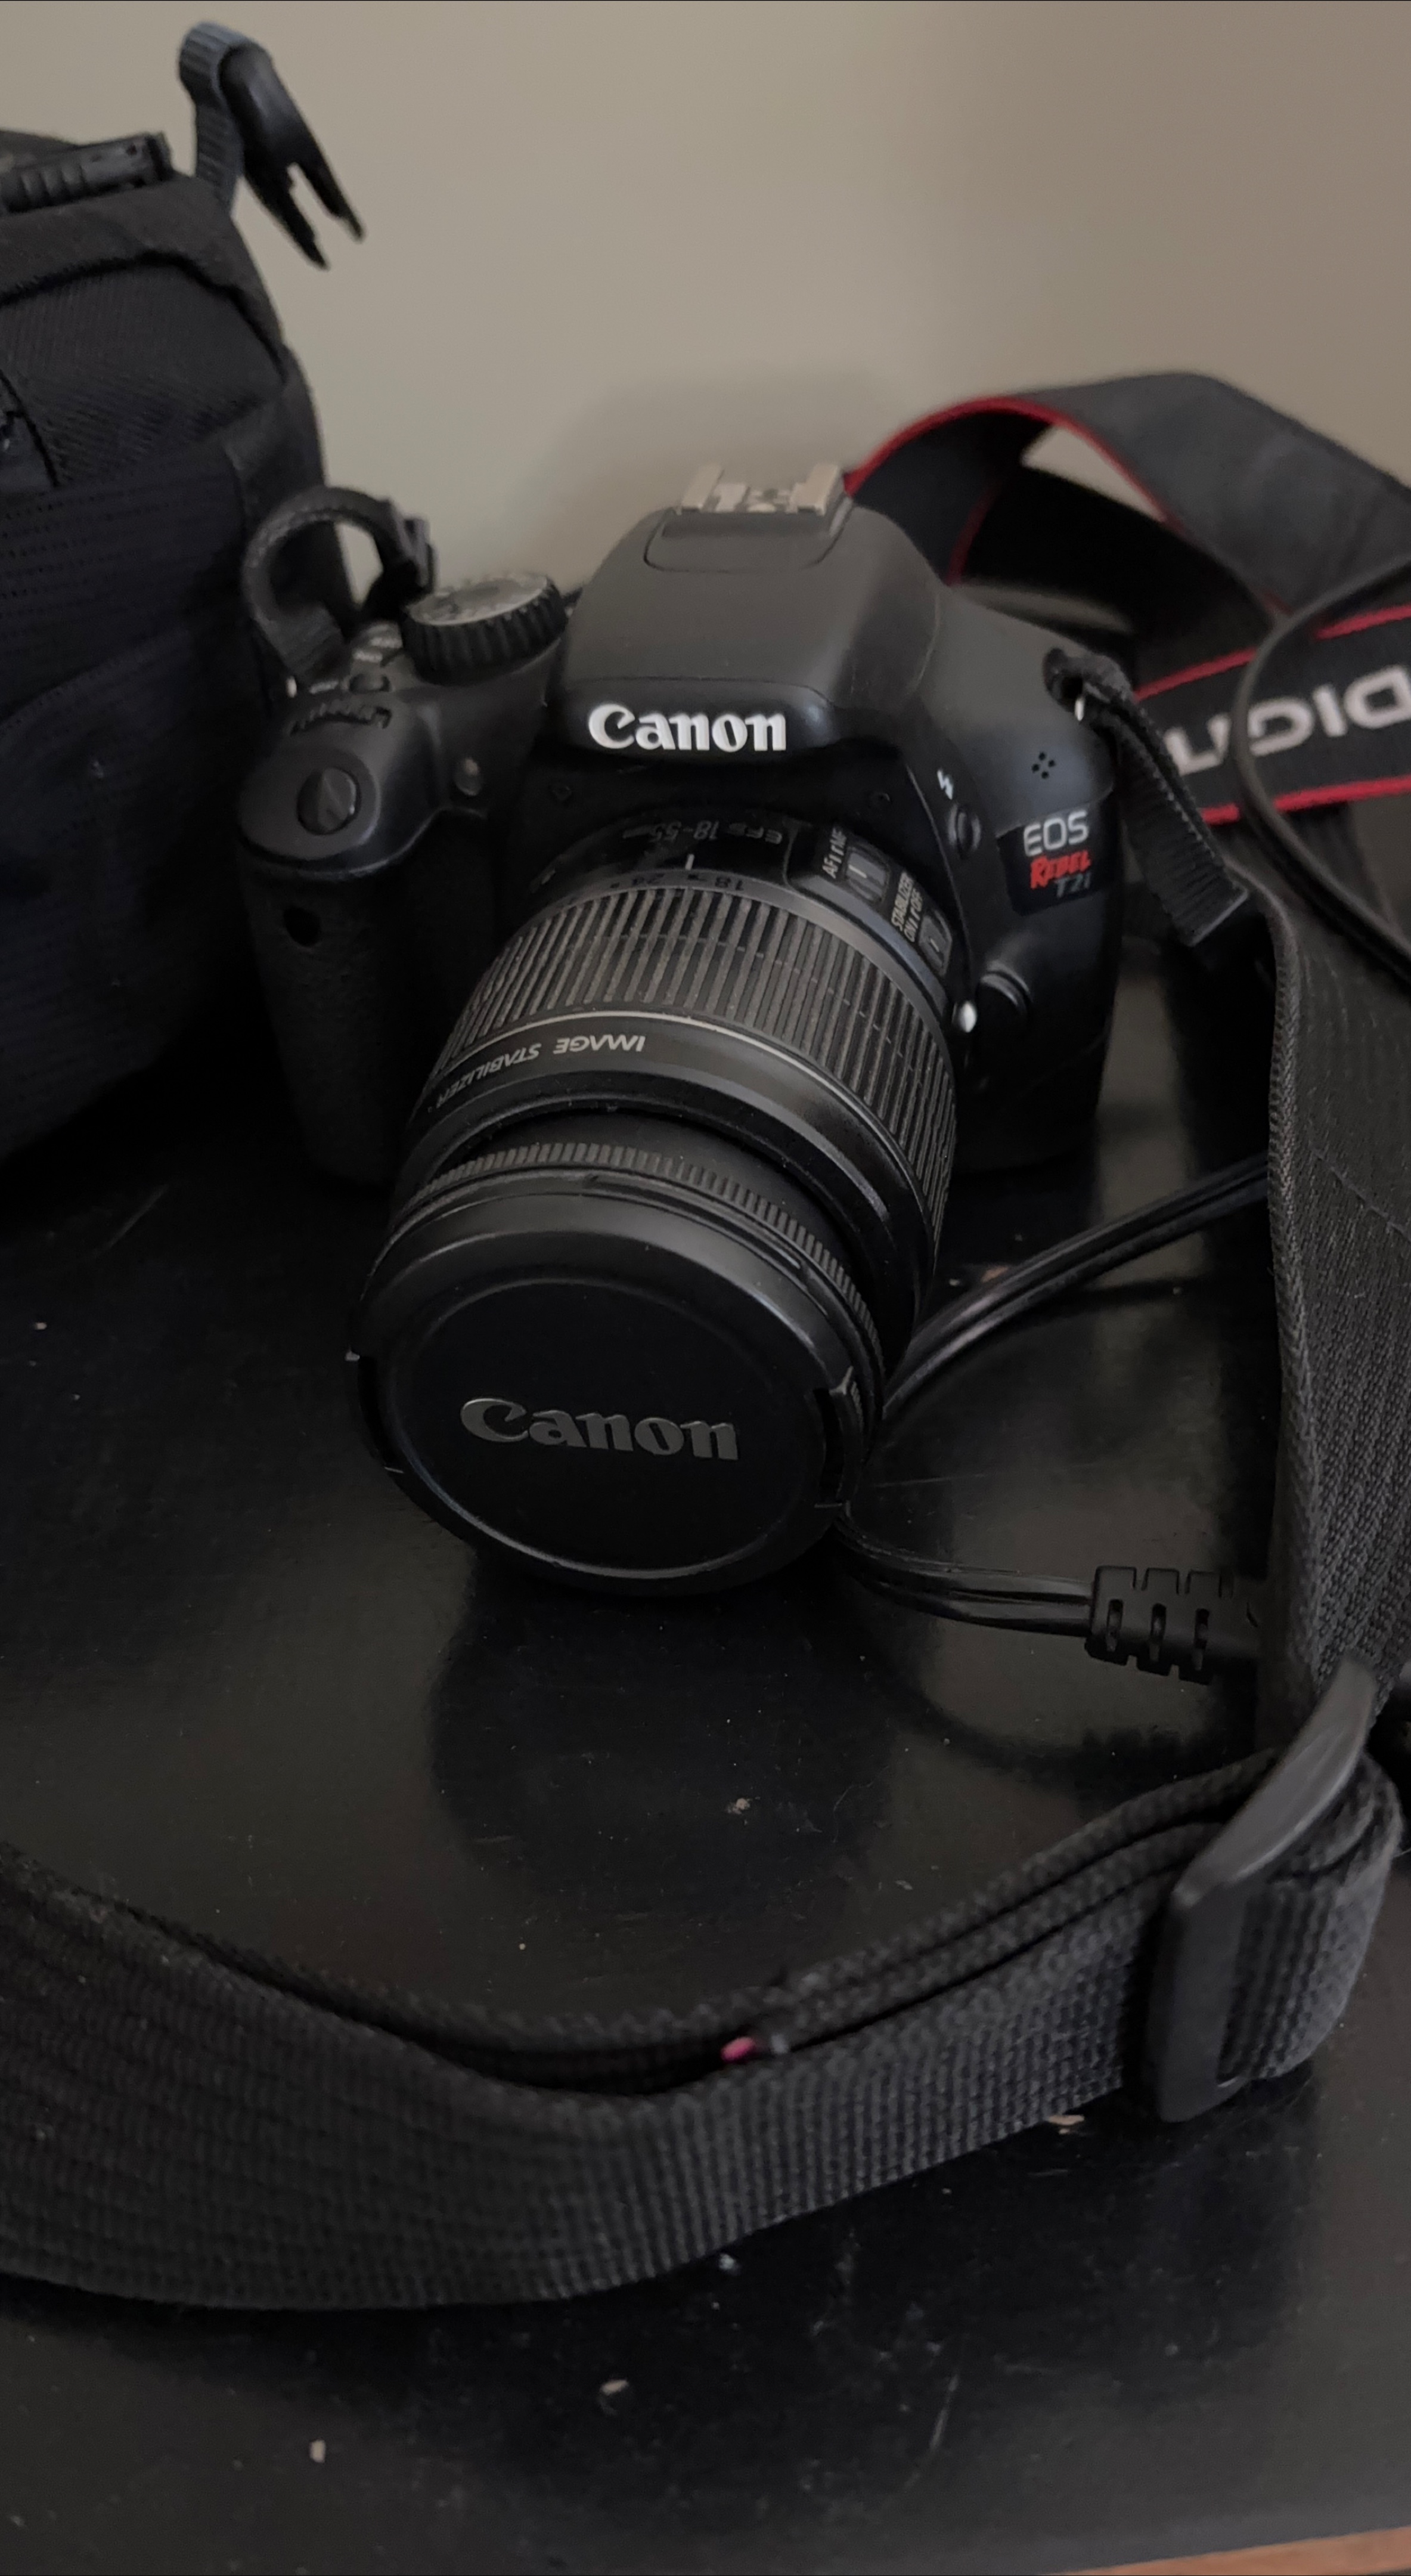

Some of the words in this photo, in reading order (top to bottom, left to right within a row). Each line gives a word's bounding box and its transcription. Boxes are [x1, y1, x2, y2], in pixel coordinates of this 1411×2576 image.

[588, 704, 787, 753] Canon
[622, 819, 719, 842] 18-55
[1023, 809, 1090, 857] EOS
[1029, 849, 1093, 890] REBEL
[1054, 870, 1092, 899] T2i
[553, 1034, 646, 1055] IMAGE
[436, 1042, 542, 1109] STABILIZER
[460, 1397, 739, 1461] Canon
